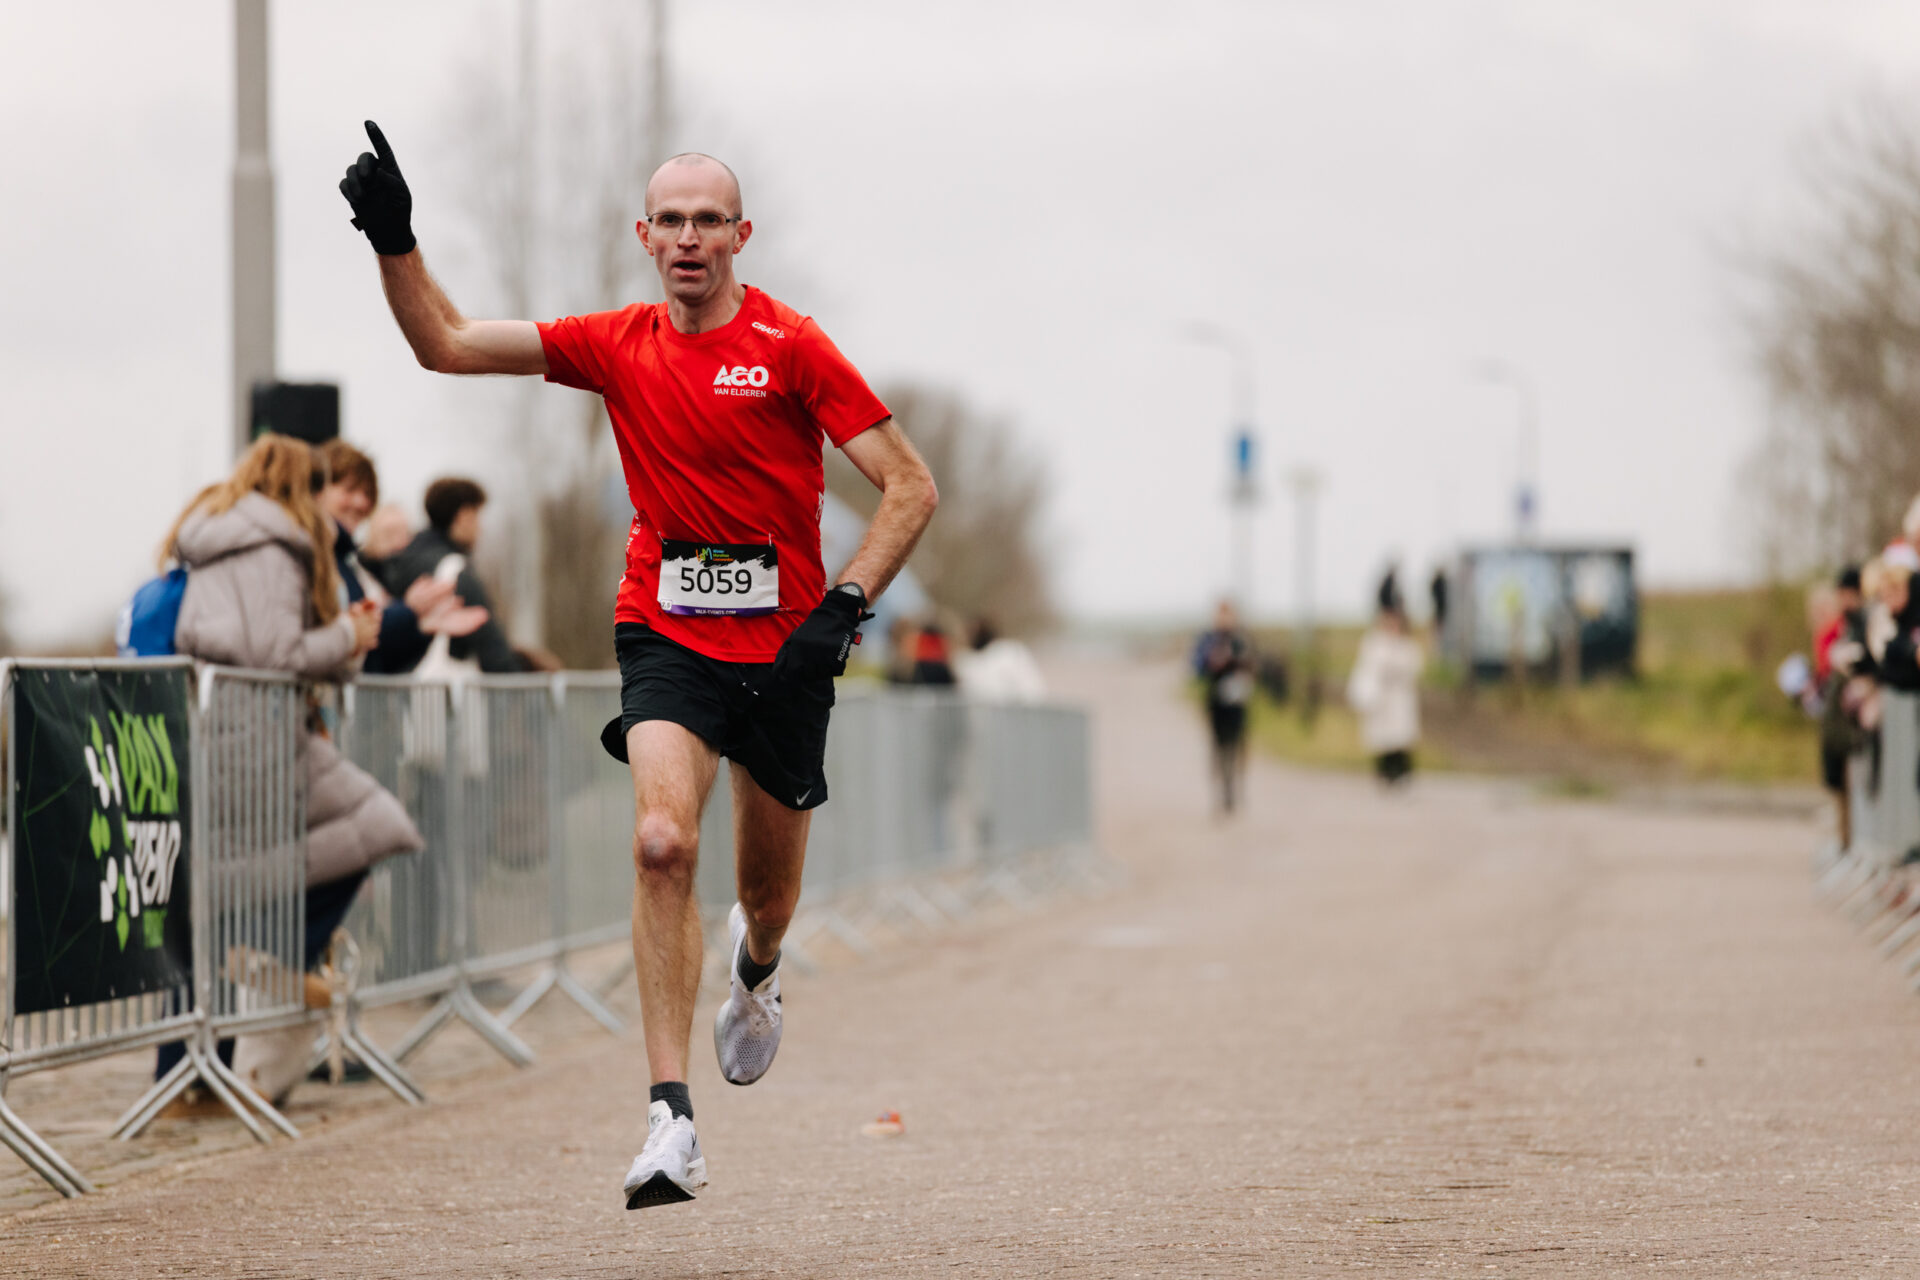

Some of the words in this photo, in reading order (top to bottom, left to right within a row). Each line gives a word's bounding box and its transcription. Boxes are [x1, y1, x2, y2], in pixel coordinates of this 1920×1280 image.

[751, 321, 779, 337] CRAFT
[713, 387, 729, 396] VAN
[730, 388, 767, 398] ELDEREN
[680, 566, 752, 595] 5059
